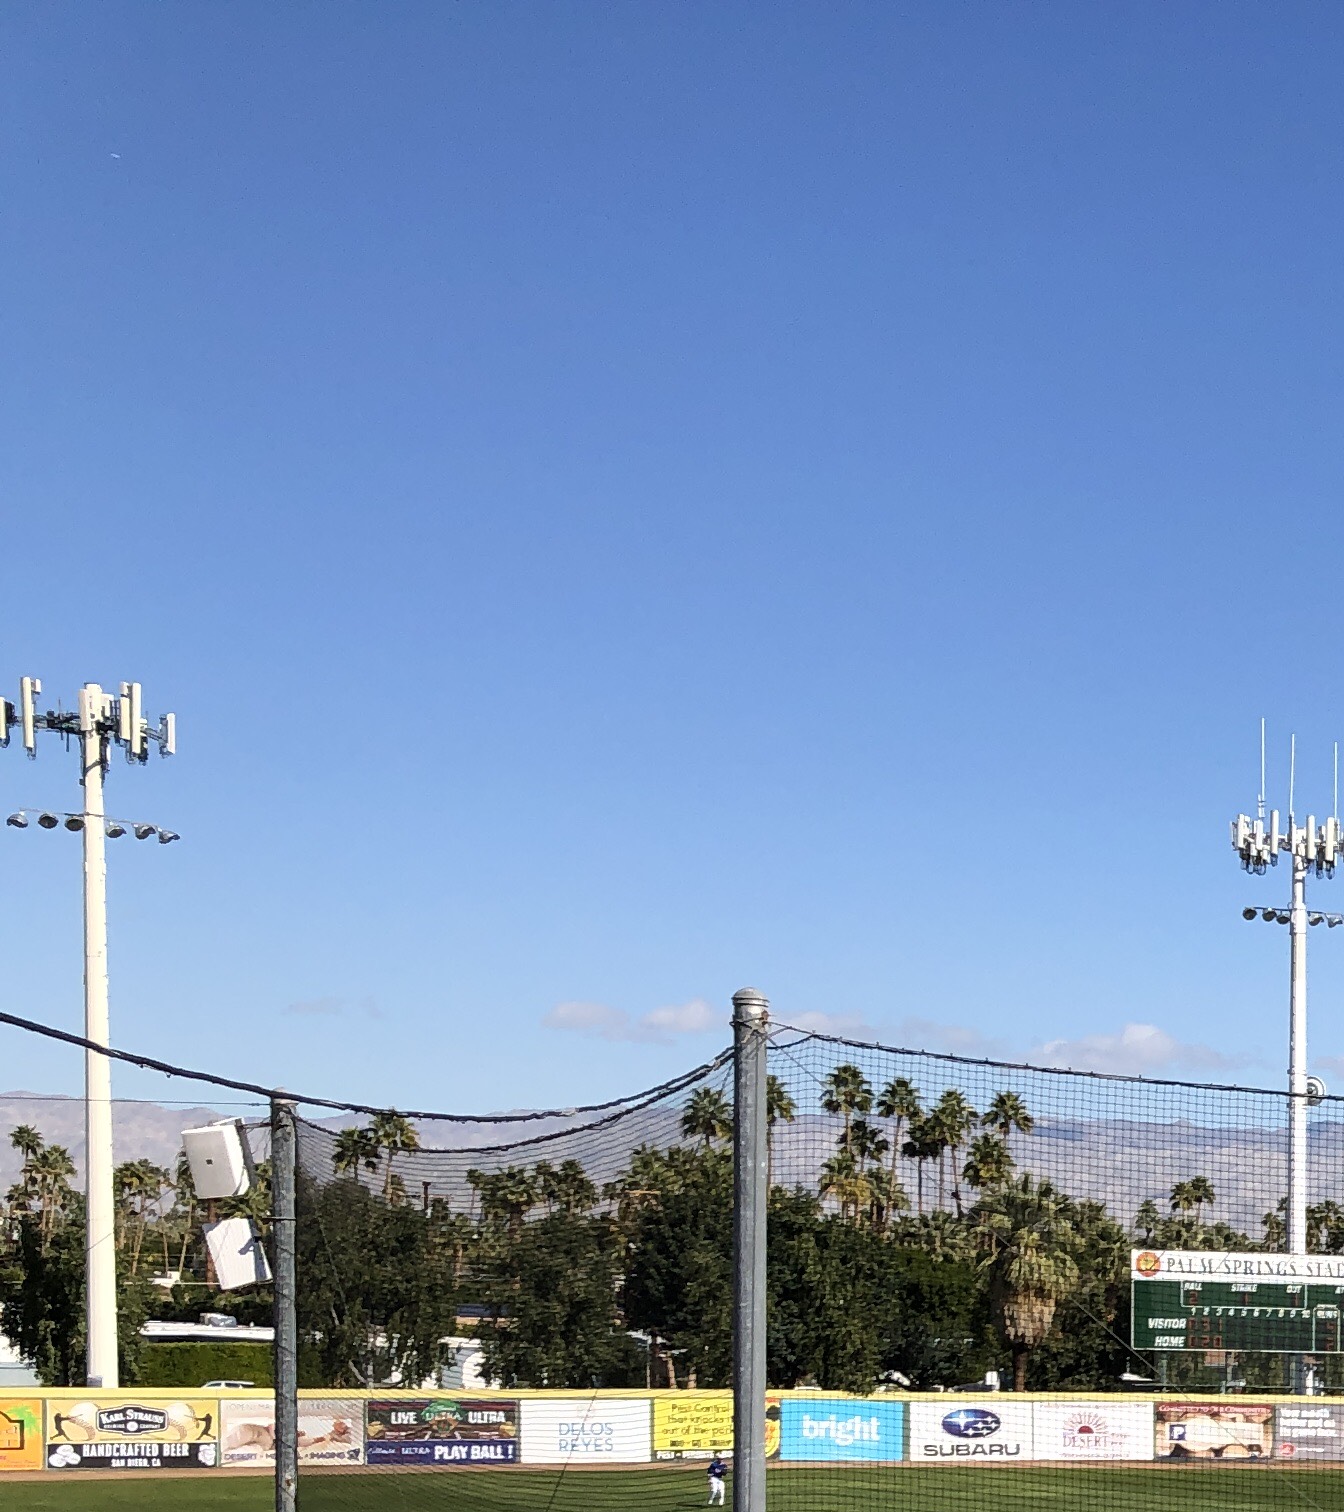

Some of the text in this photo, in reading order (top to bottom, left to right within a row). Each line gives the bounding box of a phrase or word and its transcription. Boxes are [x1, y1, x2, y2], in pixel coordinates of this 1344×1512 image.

[1167, 1257, 1213, 1272] PALM
[1224, 1259, 1297, 1276] SPRINGS
[1148, 1318, 1187, 1329] VISITOR
[1154, 1336, 1186, 1347] HOME
[390, 1411, 507, 1424] LIVE ULTRA
[559, 1422, 614, 1436] DELOS
[802, 1414, 881, 1446] bright
[559, 1438, 614, 1452] REYES
[1062, 1436, 1110, 1448] DESERT
[82, 1444, 190, 1457] HANDCRAFTED BEER
[434, 1445, 468, 1460] PLAY
[924, 1444, 1020, 1457] SUBARU
[111, 1458, 126, 1467] SAN
[152, 1458, 162, 1467] CA
